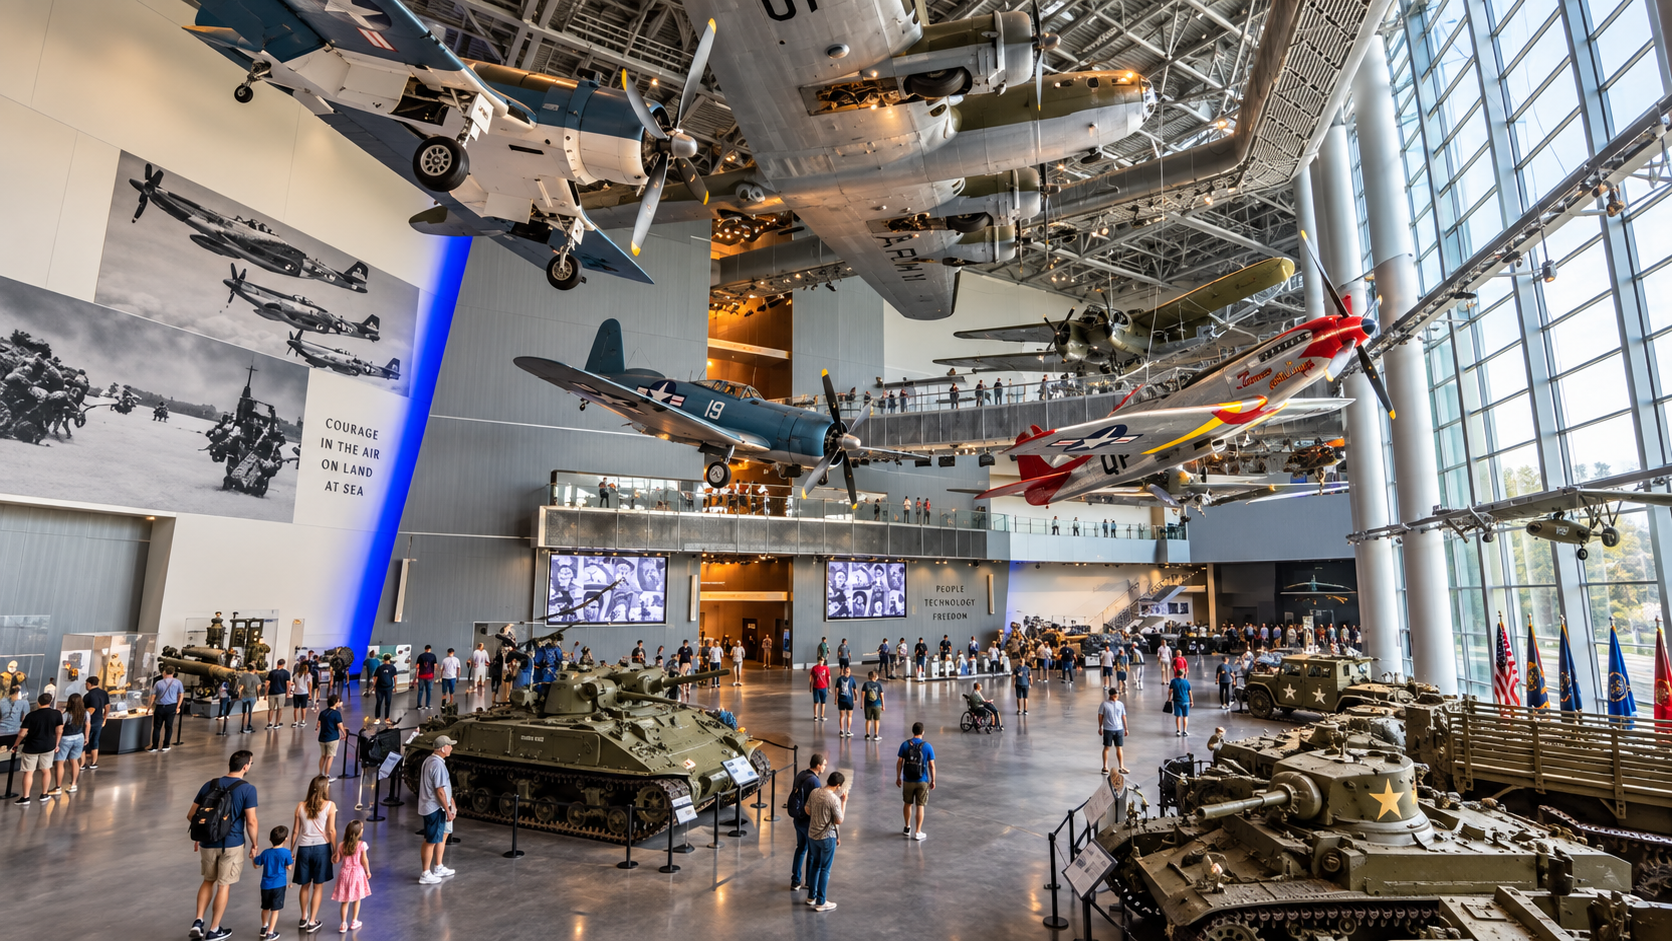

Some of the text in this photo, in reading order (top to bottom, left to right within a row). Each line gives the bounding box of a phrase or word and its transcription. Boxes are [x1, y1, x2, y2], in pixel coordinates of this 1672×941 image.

[704, 399, 726, 420] 19
[325, 417, 379, 441] COURAGE
[320, 437, 380, 460] IN THE AIR
[321, 458, 373, 478] ON LAND
[324, 480, 364, 497] AT SEA
[935, 584, 965, 593] PEOPLE
[924, 598, 976, 607] TECHNOLOGY
